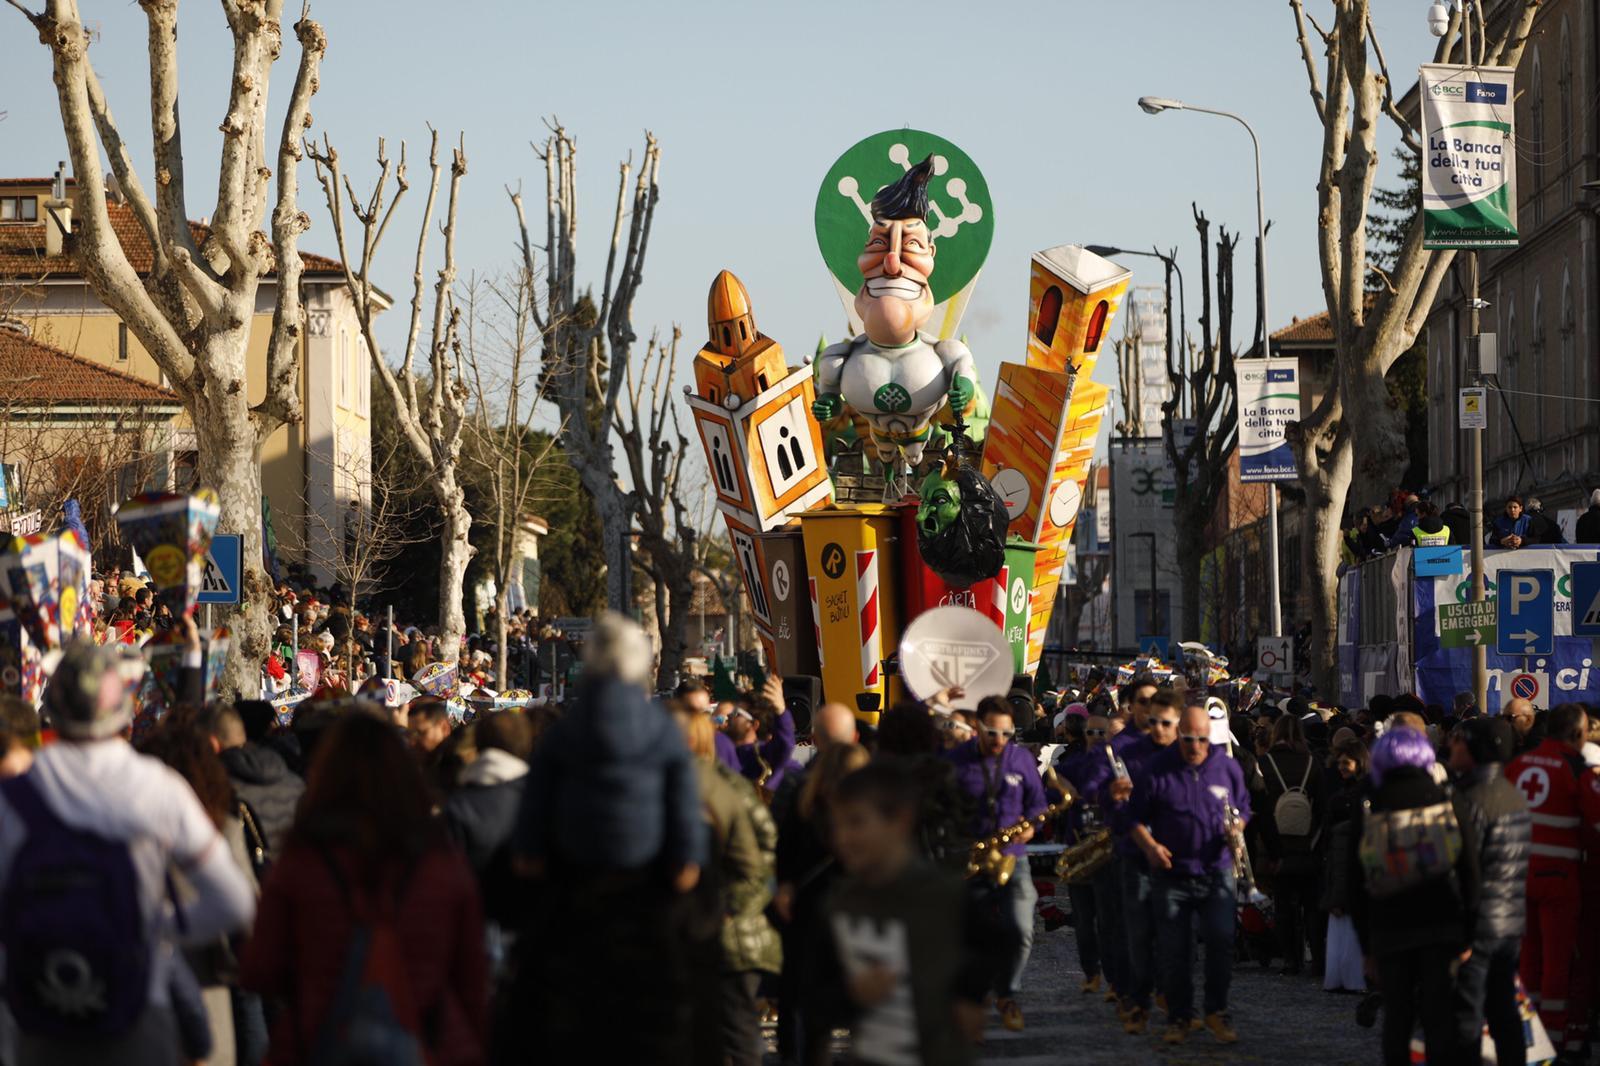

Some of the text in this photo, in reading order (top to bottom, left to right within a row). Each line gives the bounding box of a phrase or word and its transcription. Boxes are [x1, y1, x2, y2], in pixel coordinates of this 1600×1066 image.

[1442, 86, 1463, 94] BCC
[1476, 88, 1496, 98] Fano
[1430, 136, 1502, 155] La Banca
[1431, 152, 1501, 172] della tua
[1451, 170, 1482, 187] città
[1244, 406, 1295, 417] La Banca
[1244, 416, 1272, 428] della
[826, 548, 841, 574] R
[776, 566, 788, 595] R
[1014, 585, 1024, 608] R
[1510, 575, 1541, 616] P
[1447, 602, 1495, 617] USCITA DI
[1441, 614, 1497, 630] EMERGENZ
[1555, 658, 1592, 691] ci
